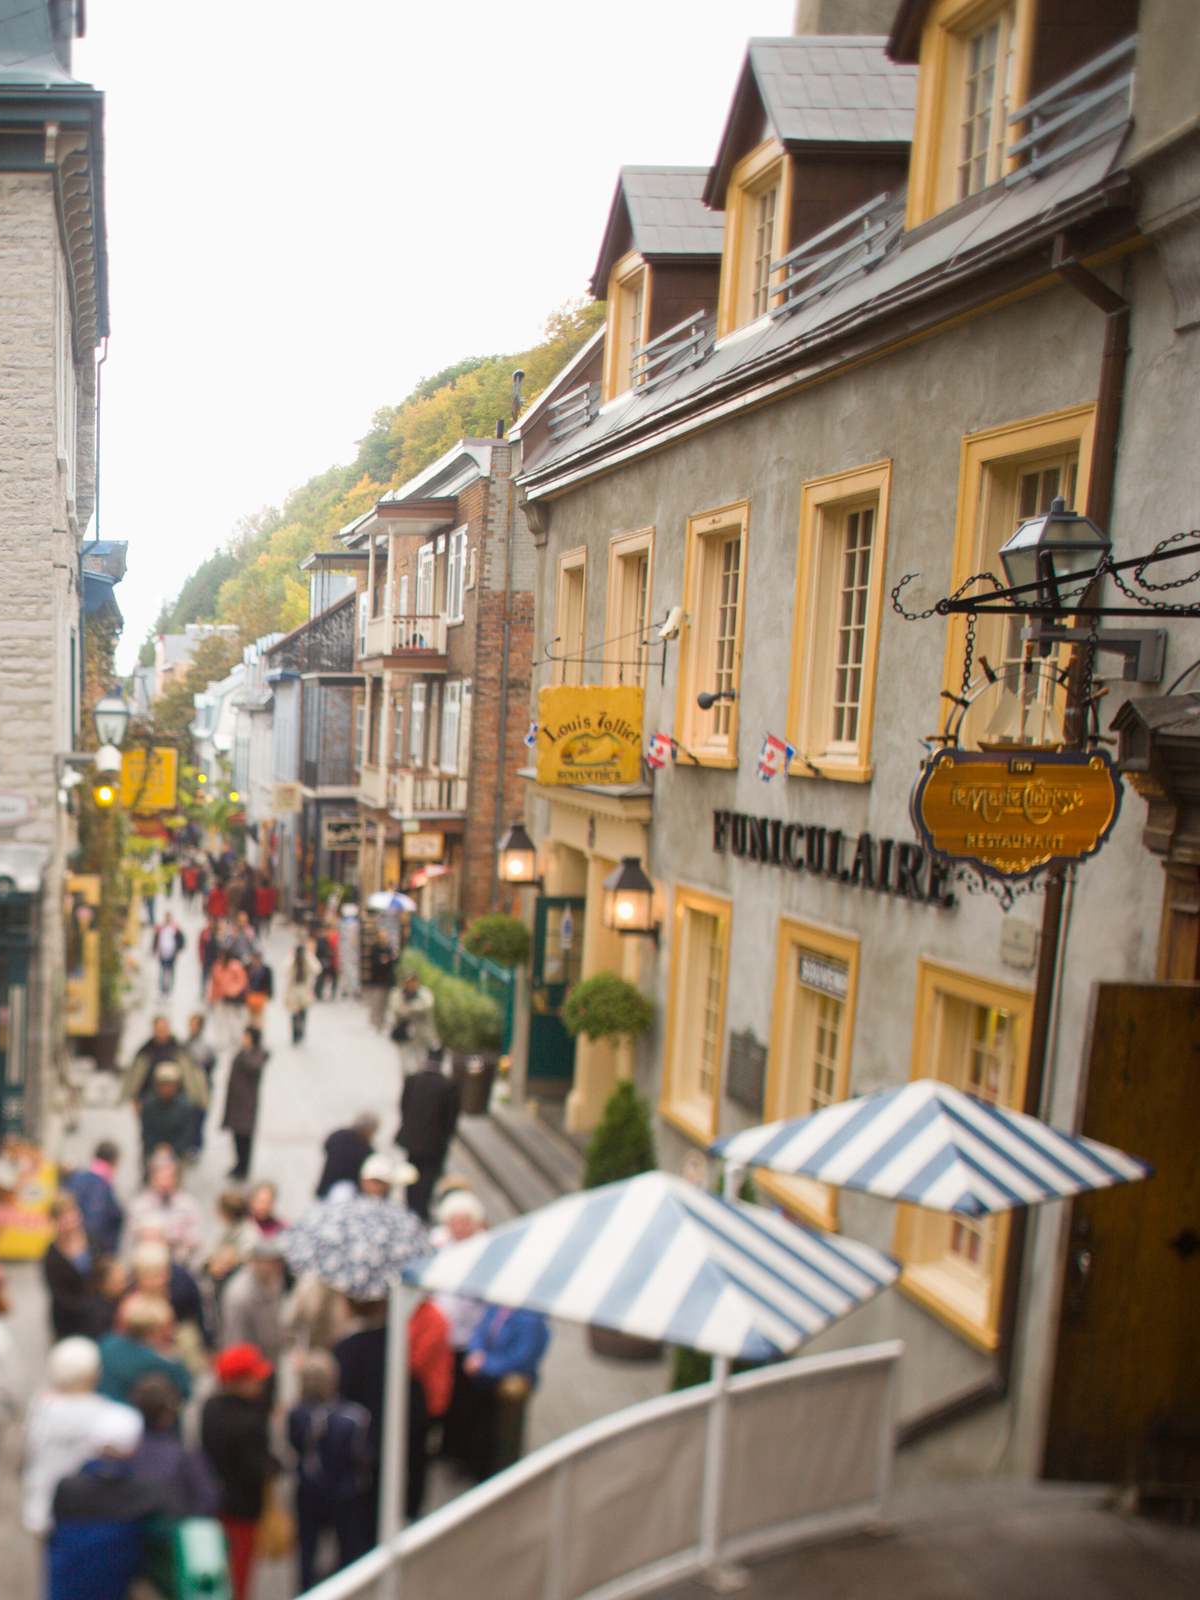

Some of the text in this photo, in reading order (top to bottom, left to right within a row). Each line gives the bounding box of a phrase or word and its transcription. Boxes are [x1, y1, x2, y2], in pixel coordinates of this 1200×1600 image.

[543, 710, 642, 745] Louis Jolliet
[1022, 778, 1085, 825] Clarisse
[712, 809, 958, 908] FUNICULAIRE
[965, 832, 1065, 849] RESTAURANT
